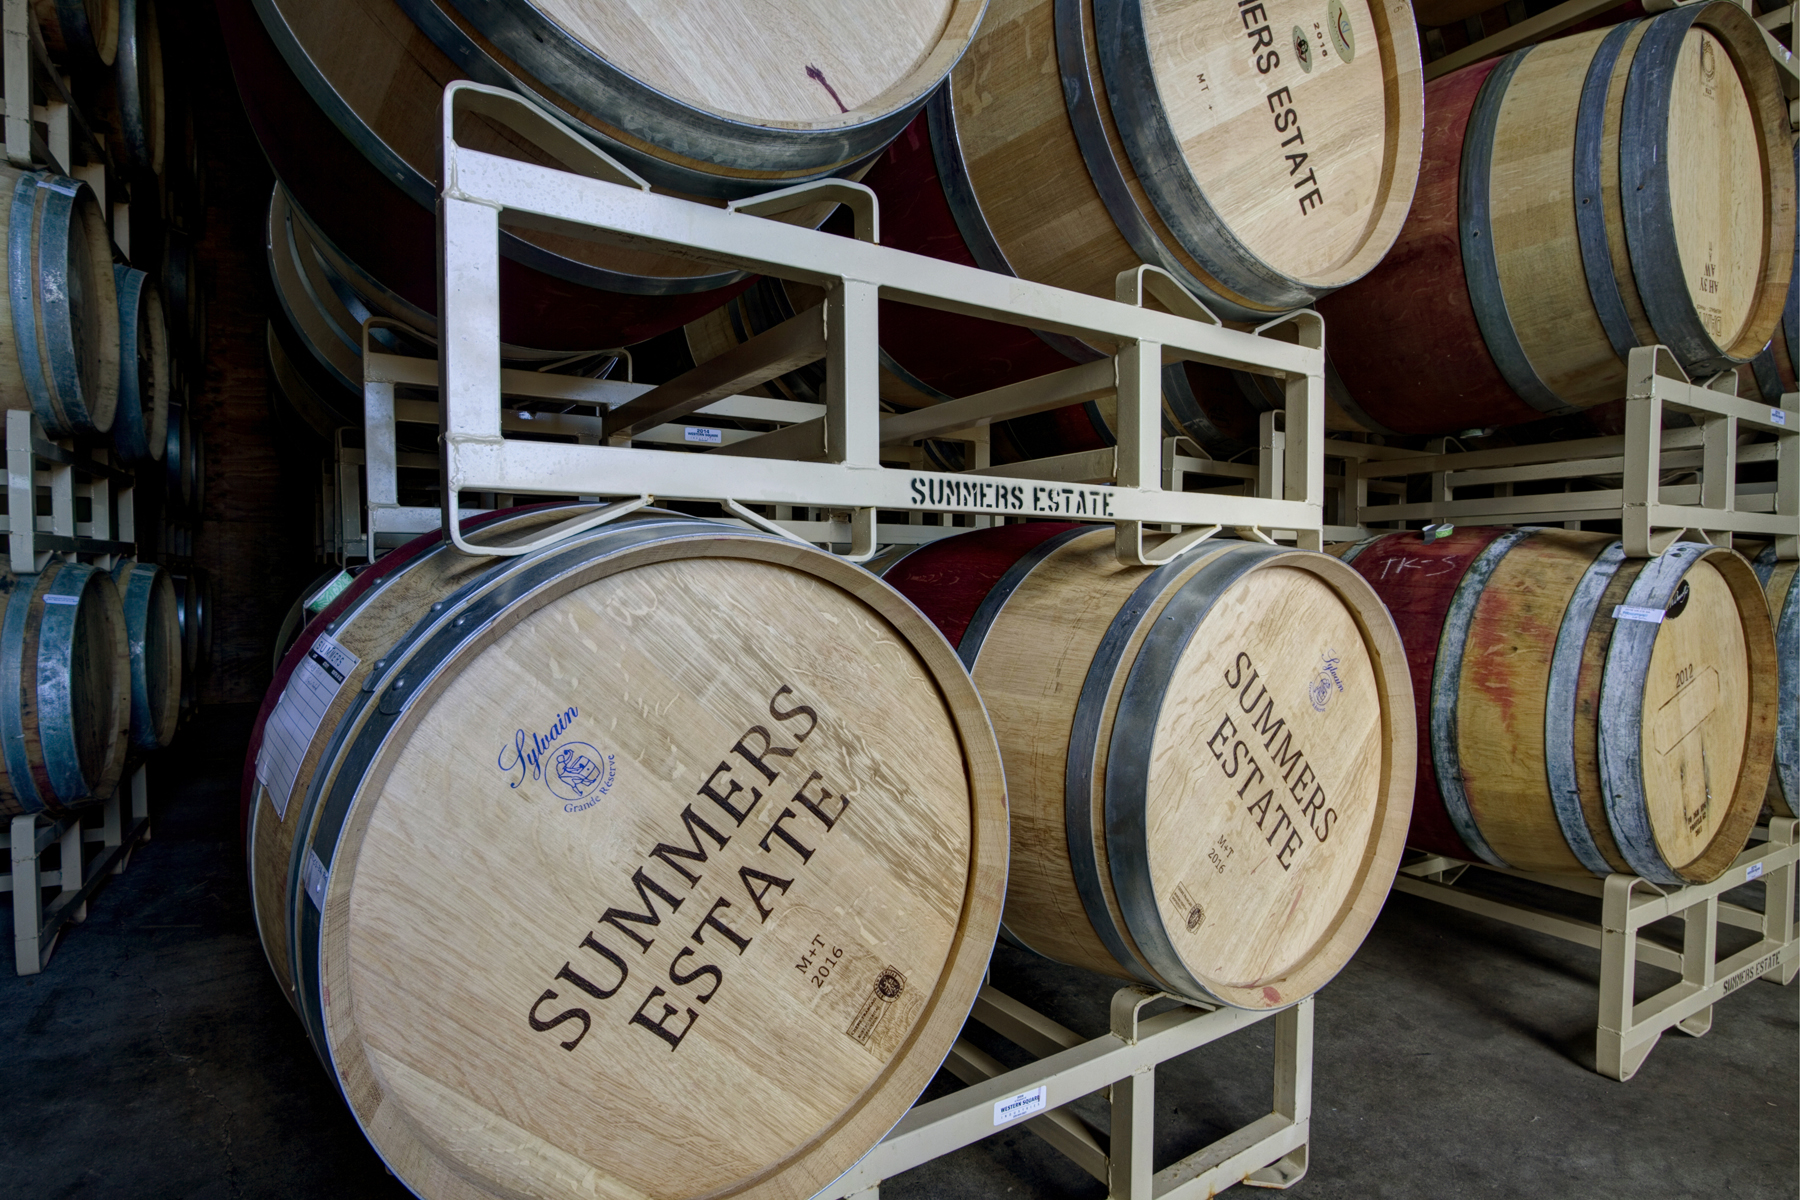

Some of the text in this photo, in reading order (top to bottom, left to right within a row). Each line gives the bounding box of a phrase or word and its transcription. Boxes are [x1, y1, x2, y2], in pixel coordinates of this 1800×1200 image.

[1313, 22, 1328, 57] 2016
[1266, 85, 1323, 216] ESTATE
[911, 477, 1114, 517] SUMMERS ESTATE
[1321, 648, 1344, 692] Sylvain
[1675, 663, 1694, 688] 2012
[498, 706, 579, 789] Sylvain
[1224, 652, 1338, 843] SUMMERS
[564, 754, 616, 813] Grande Réserve
[1207, 712, 1304, 872] ESTATE
[528, 684, 818, 1052] SUMMERS
[1208, 848, 1226, 874] 2016
[1217, 834, 1234, 858] M+T
[628, 770, 851, 1053] ESTATE
[795, 934, 825, 975] M+T
[811, 946, 844, 988] 2016
[1723, 950, 1781, 995] SUMMERS ESTATE
[1000, 1101, 1022, 1113] WESTERN
